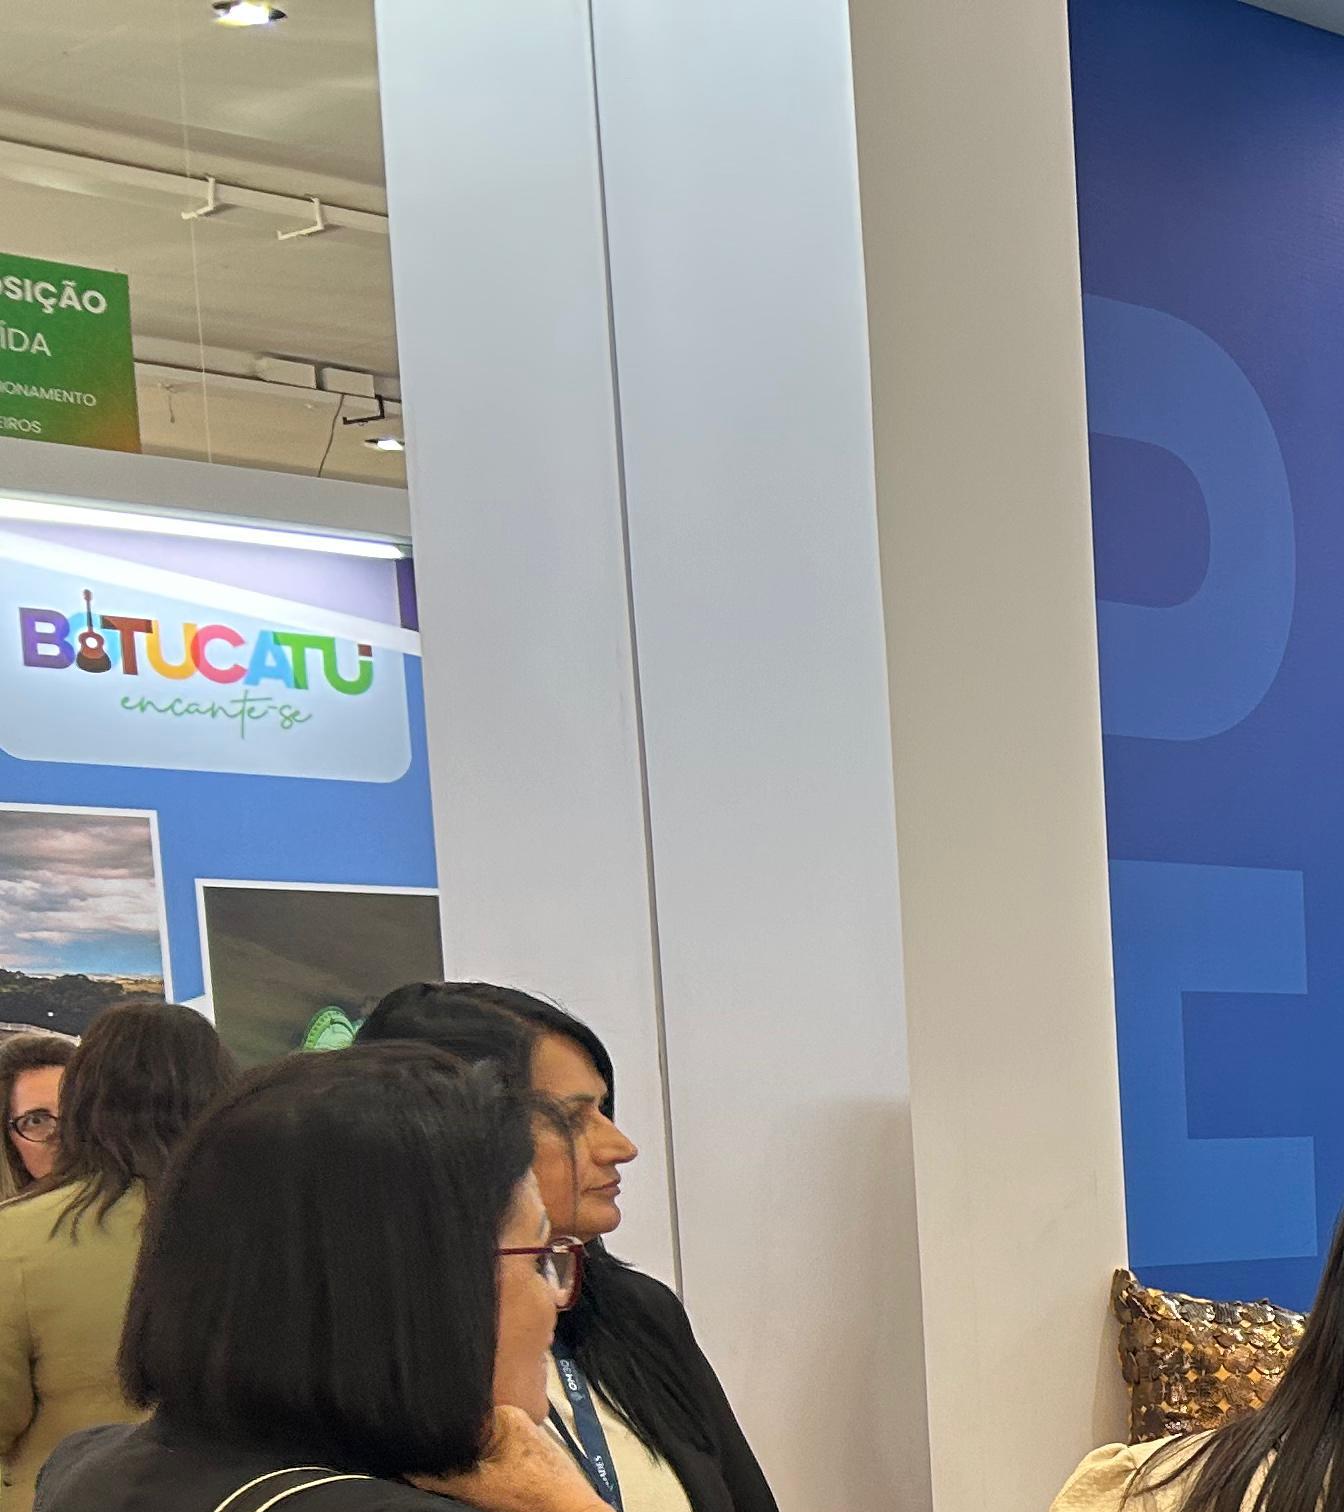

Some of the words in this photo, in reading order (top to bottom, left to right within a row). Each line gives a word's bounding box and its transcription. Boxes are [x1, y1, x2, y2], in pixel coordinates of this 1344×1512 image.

[0, 275, 108, 314] SIÇÃO
[18, 604, 374, 697] BOTUCATU
[119, 688, 314, 740] encante-se
